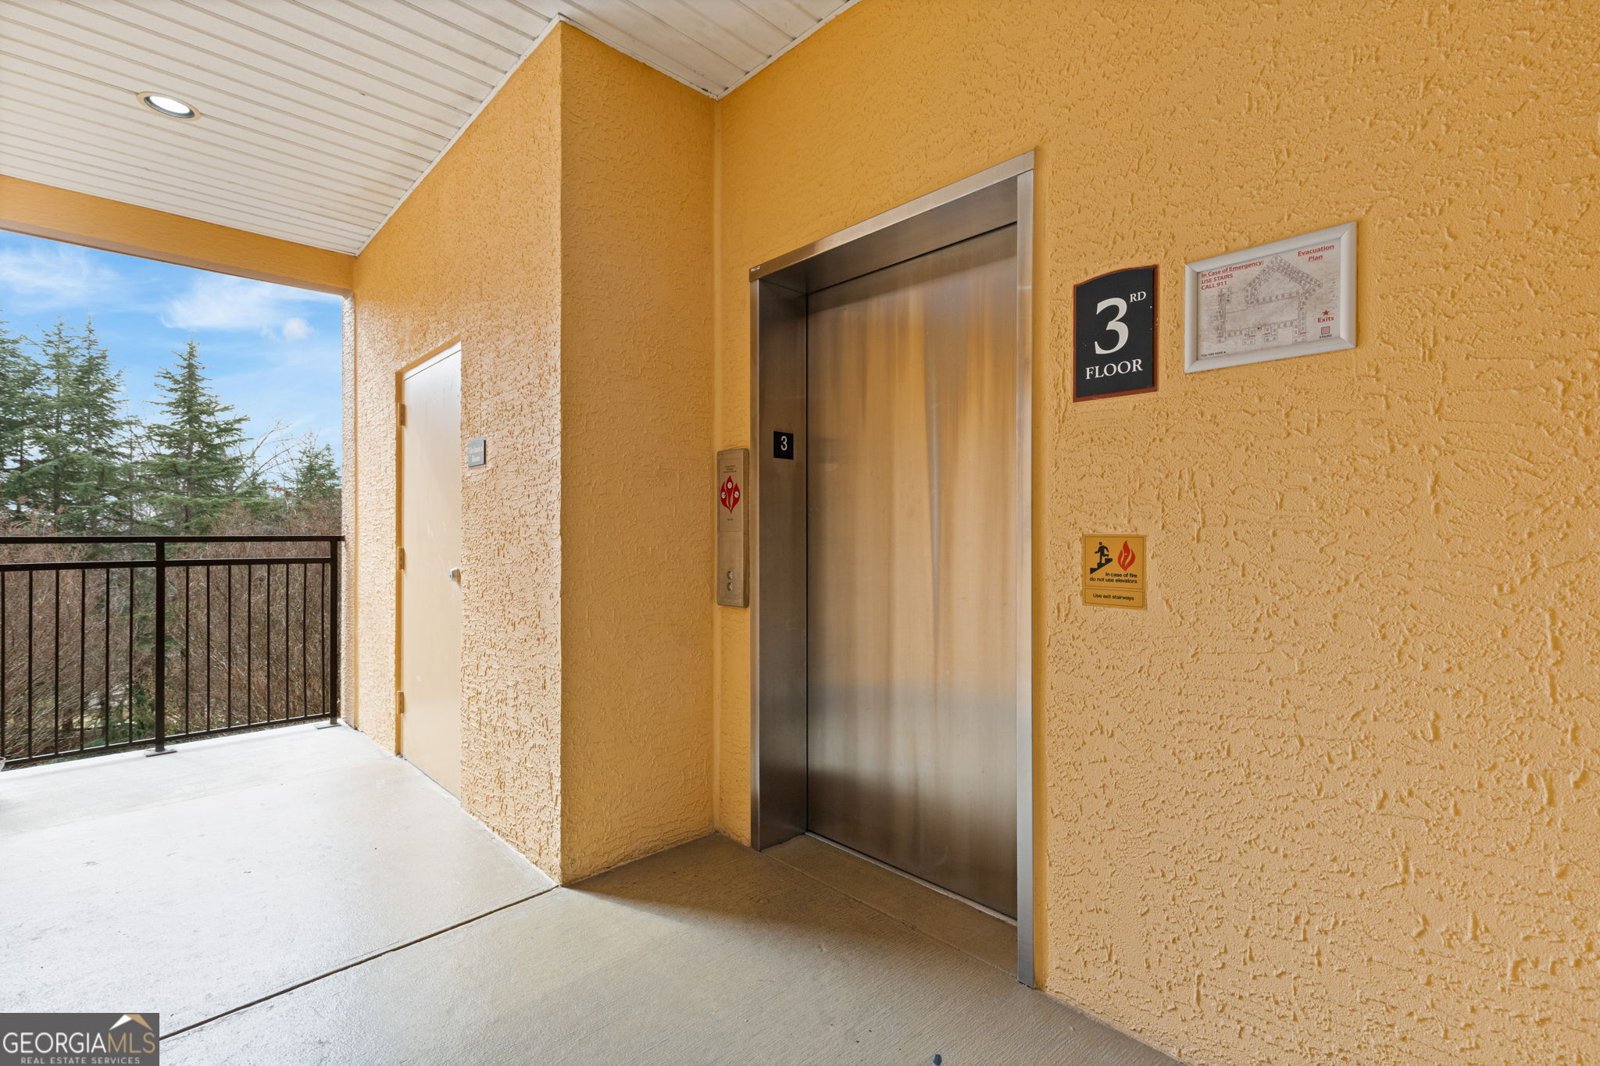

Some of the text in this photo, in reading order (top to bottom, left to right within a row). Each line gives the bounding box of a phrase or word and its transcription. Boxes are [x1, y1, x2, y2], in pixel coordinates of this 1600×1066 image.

[1297, 244, 1335, 257] Evacuation
[1213, 273, 1233, 282] STAIRS
[1085, 358, 1143, 380] FLOOR
[780, 435, 788, 451] 3
